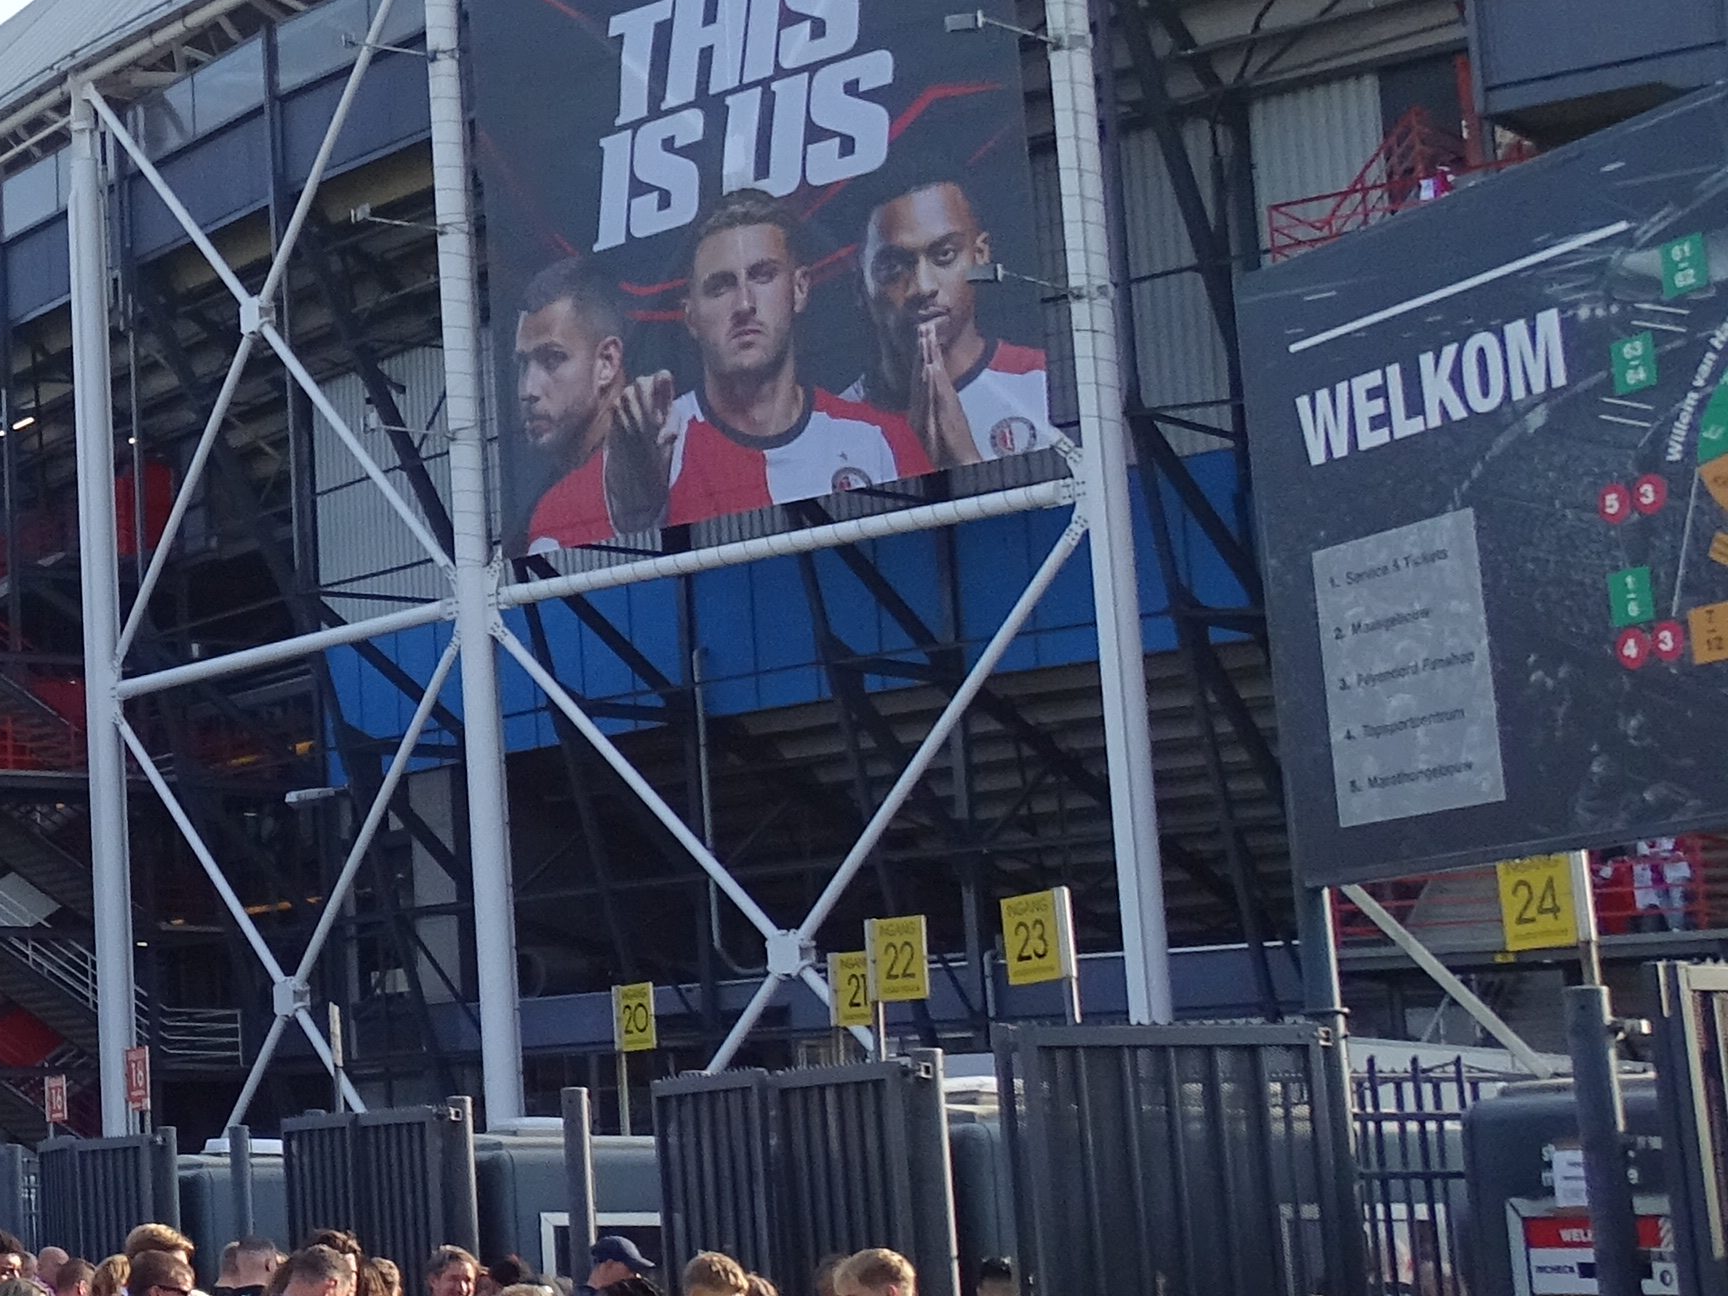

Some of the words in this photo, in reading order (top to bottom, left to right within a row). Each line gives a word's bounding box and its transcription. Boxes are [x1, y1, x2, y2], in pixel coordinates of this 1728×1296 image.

[593, 108, 704, 252] IS
[722, 49, 894, 198] US
[1295, 307, 1568, 467] WELKOM
[1604, 493, 1620, 515] 5
[1639, 483, 1655, 505] 3
[1622, 638, 1638, 658] 4
[1658, 630, 1674, 651] 3
[1511, 875, 1561, 926] 24
[1014, 918, 1049, 962] 23
[884, 941, 916, 980] 22
[847, 973, 868, 1008] 21
[622, 1003, 648, 1035] 20
